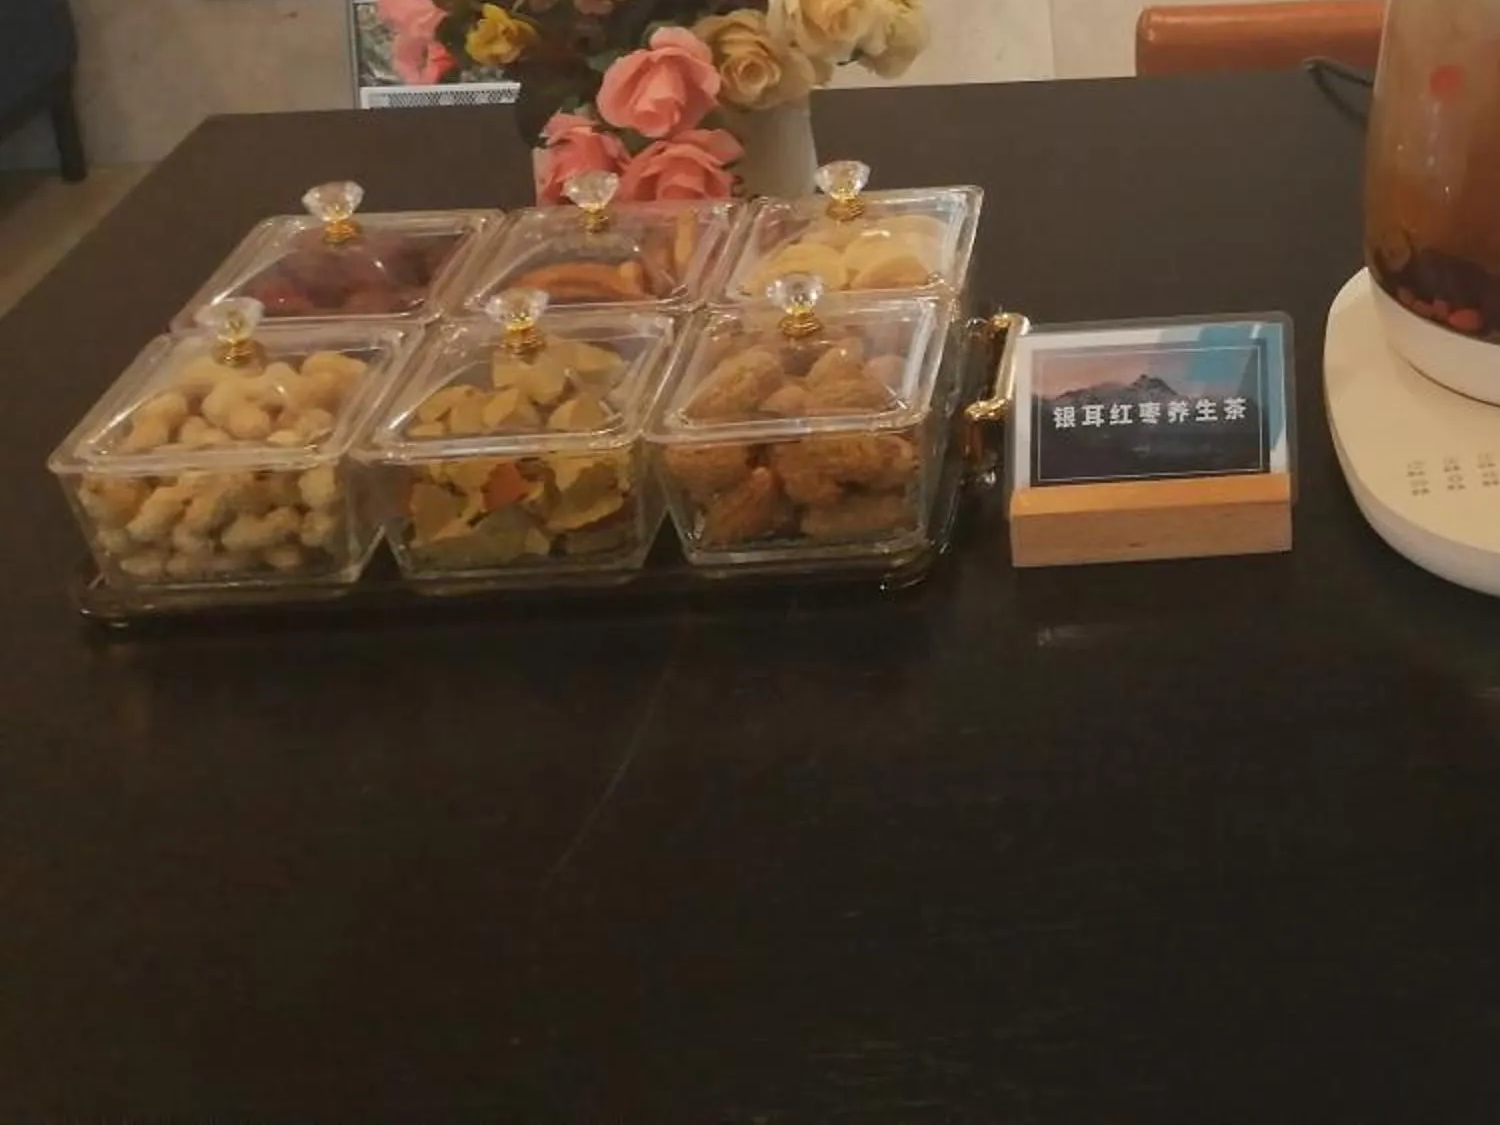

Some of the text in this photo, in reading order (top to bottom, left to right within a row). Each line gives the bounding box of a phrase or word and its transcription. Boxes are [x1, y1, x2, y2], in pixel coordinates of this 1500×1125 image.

[1053, 397, 1247, 429] 银耳红枣养生茶
